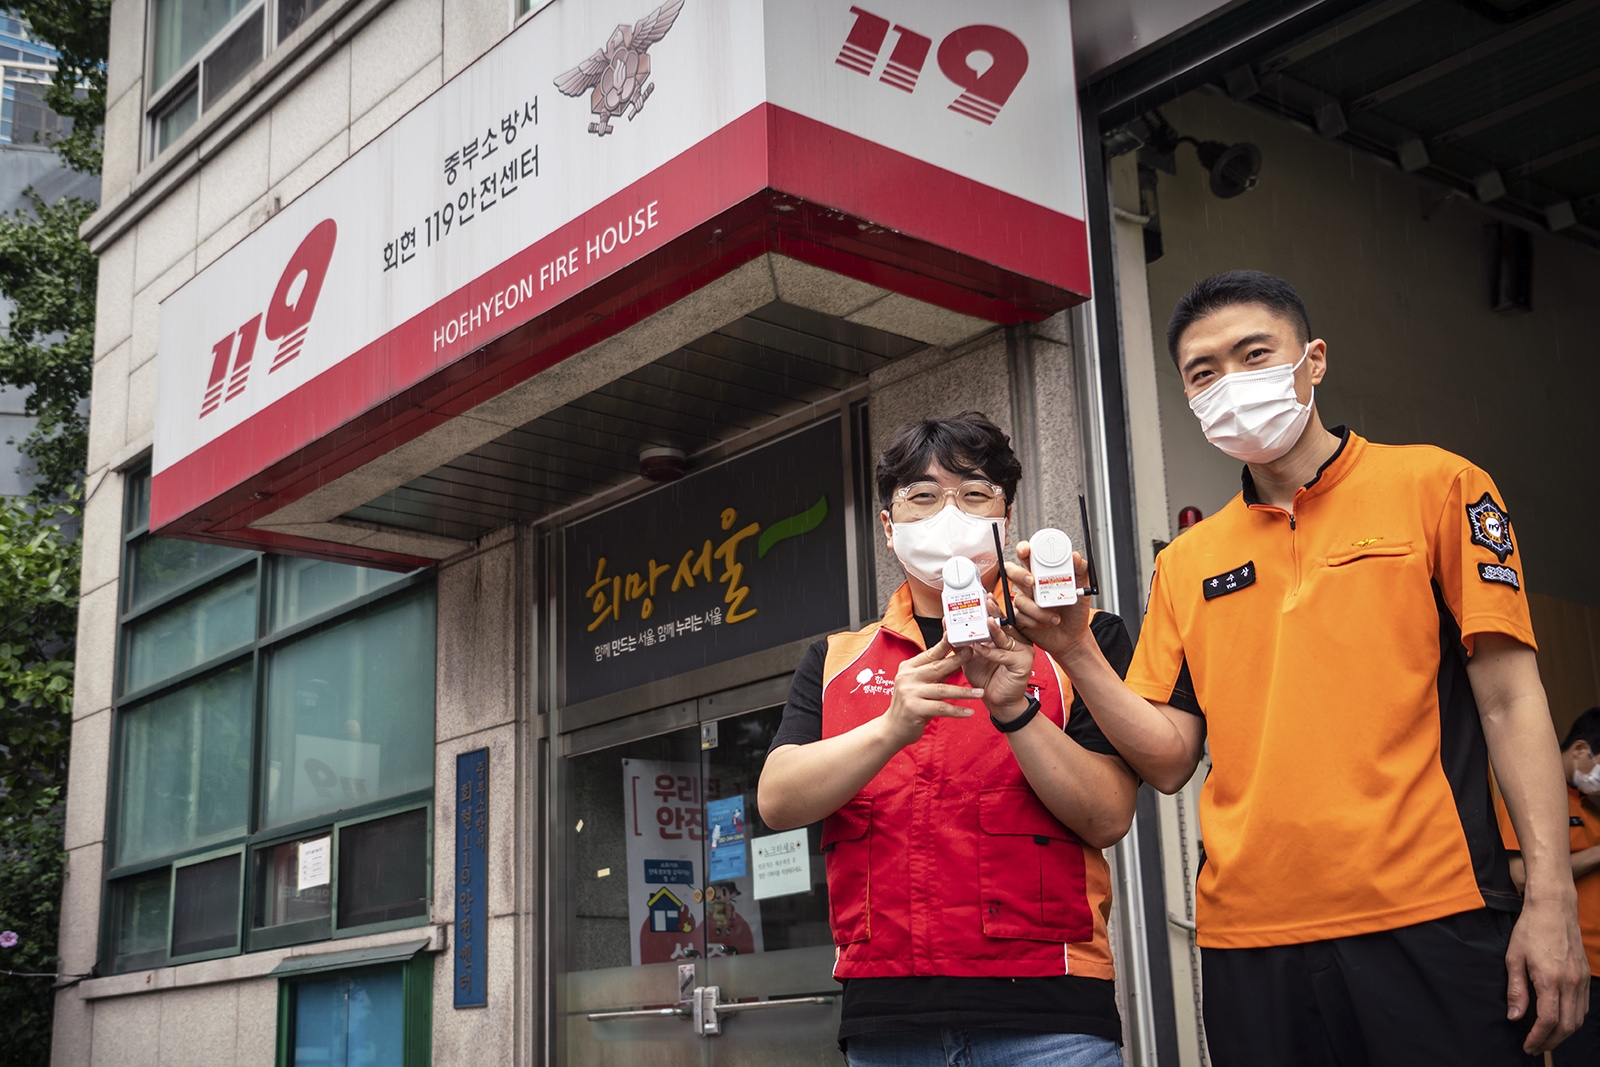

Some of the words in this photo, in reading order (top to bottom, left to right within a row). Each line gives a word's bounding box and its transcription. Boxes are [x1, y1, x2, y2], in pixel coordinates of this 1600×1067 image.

[835, 5, 1029, 126] 119
[444, 95, 538, 186] 중부소방서
[383, 227, 416, 272] 회현
[425, 144, 539, 247] 119안전센터
[199, 218, 337, 419] 119
[433, 275, 532, 352] HOEHYEON
[540, 248, 579, 291] FIRE
[586, 200, 659, 264] HOUSE
[586, 557, 671, 632] 희망
[671, 508, 761, 624] 서울
[594, 642, 611, 662] 함께
[612, 635, 637, 657] 만드는
[638, 629, 657, 646] 서울,
[657, 622, 675, 642] 함께
[676, 614, 703, 636] 누리는
[704, 606, 722, 626] 서울
